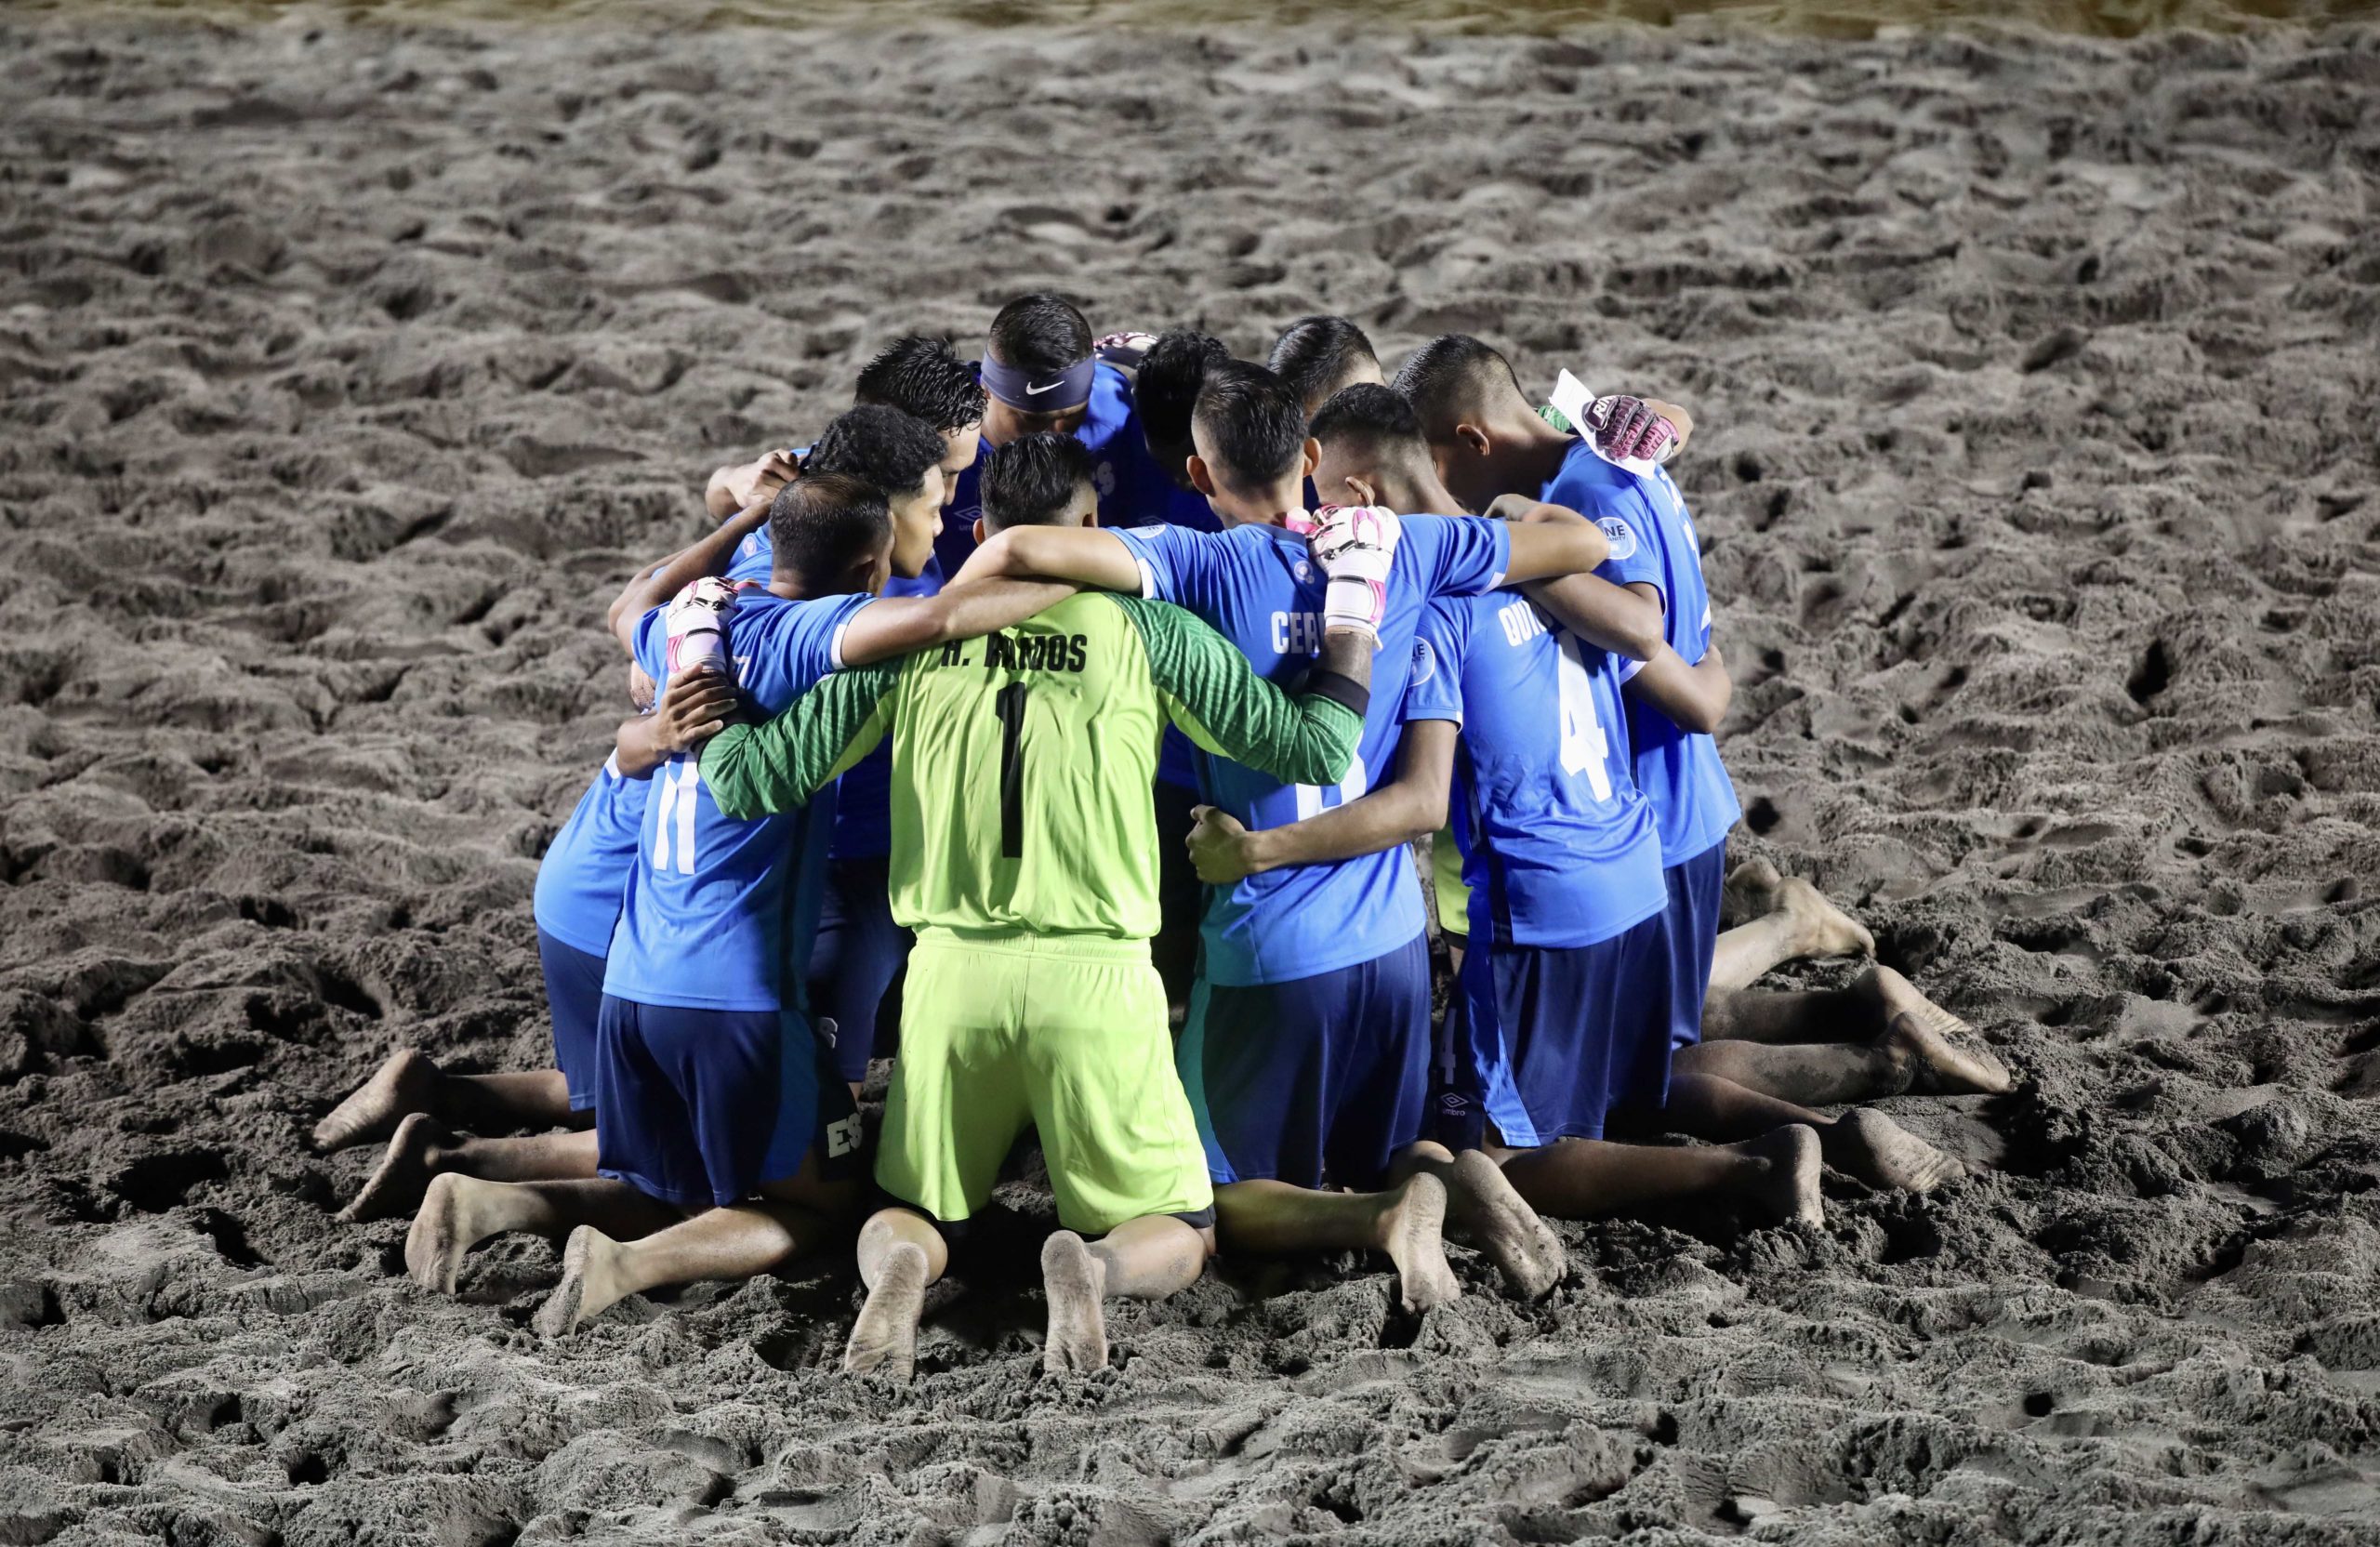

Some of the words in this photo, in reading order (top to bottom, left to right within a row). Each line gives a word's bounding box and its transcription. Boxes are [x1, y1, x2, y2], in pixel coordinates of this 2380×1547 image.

[984, 630, 1088, 672] RAMOS
[995, 681, 1025, 858] 1
[1558, 629, 1603, 802] 4
[653, 752, 699, 875] 11
[826, 1113, 863, 1158] ES
